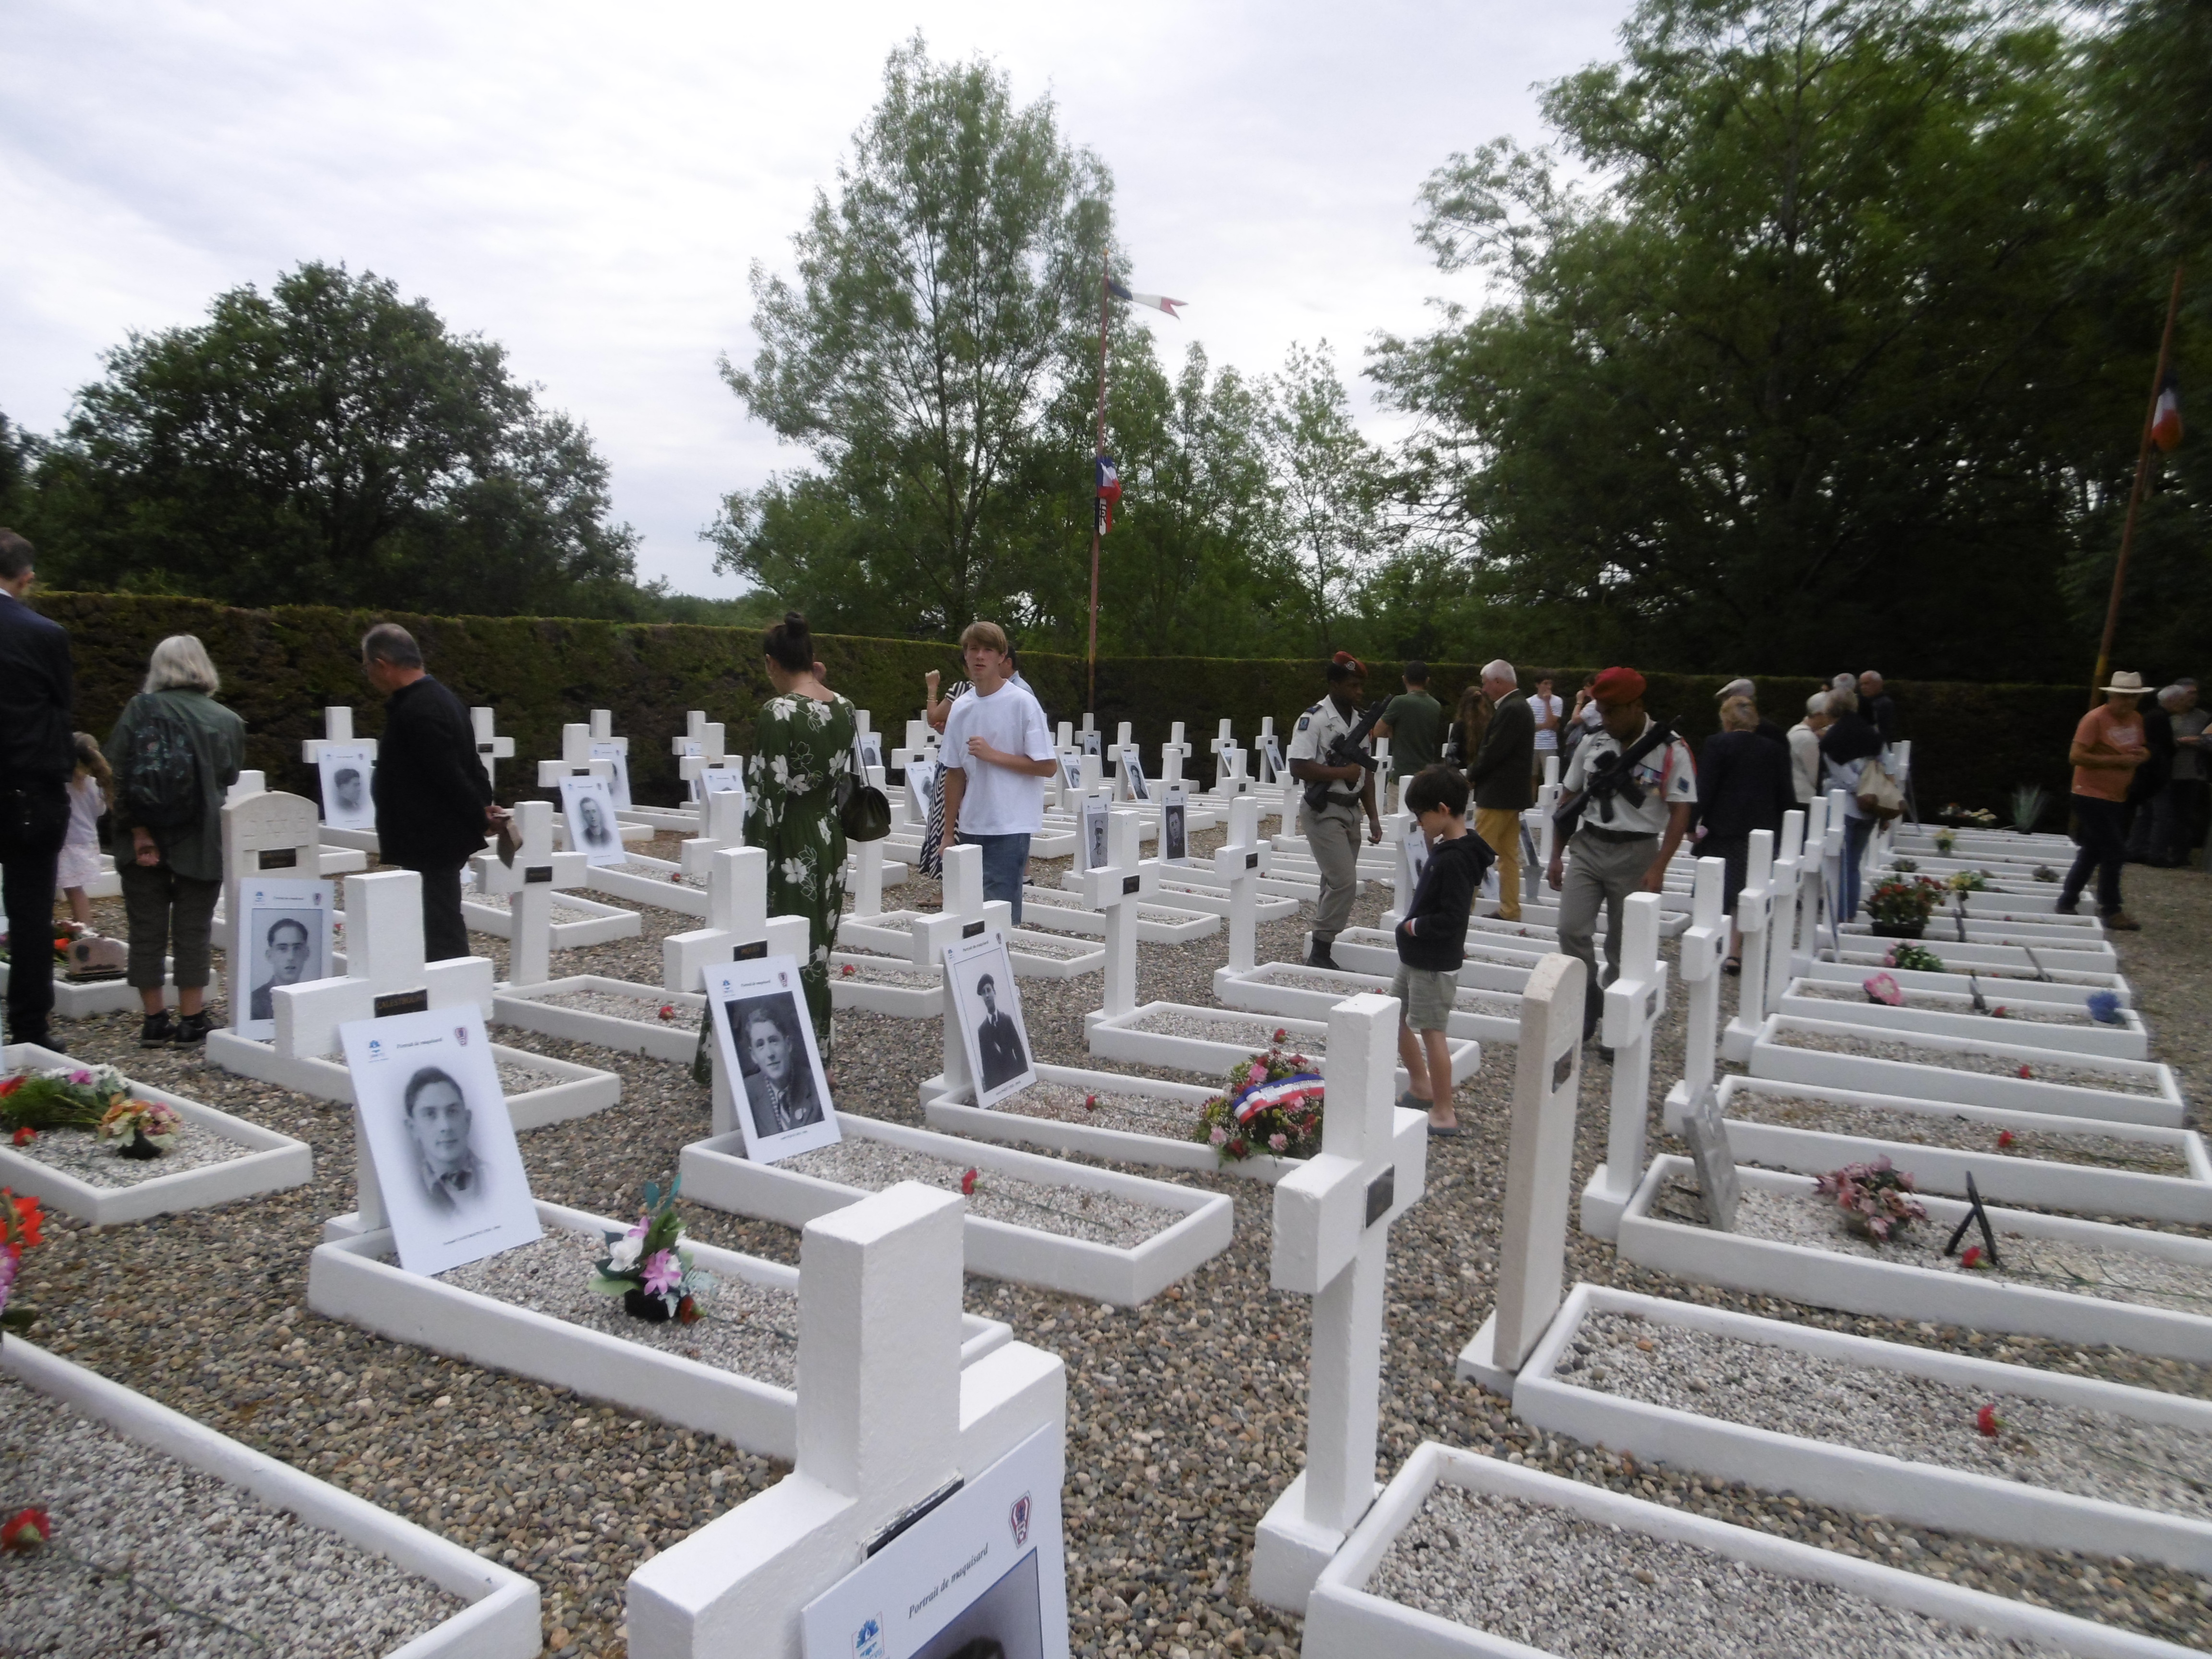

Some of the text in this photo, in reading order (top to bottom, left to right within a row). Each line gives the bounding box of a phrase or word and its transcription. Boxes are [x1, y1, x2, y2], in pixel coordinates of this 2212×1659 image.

[908, 1542, 988, 1619] Portrait de maquisard
